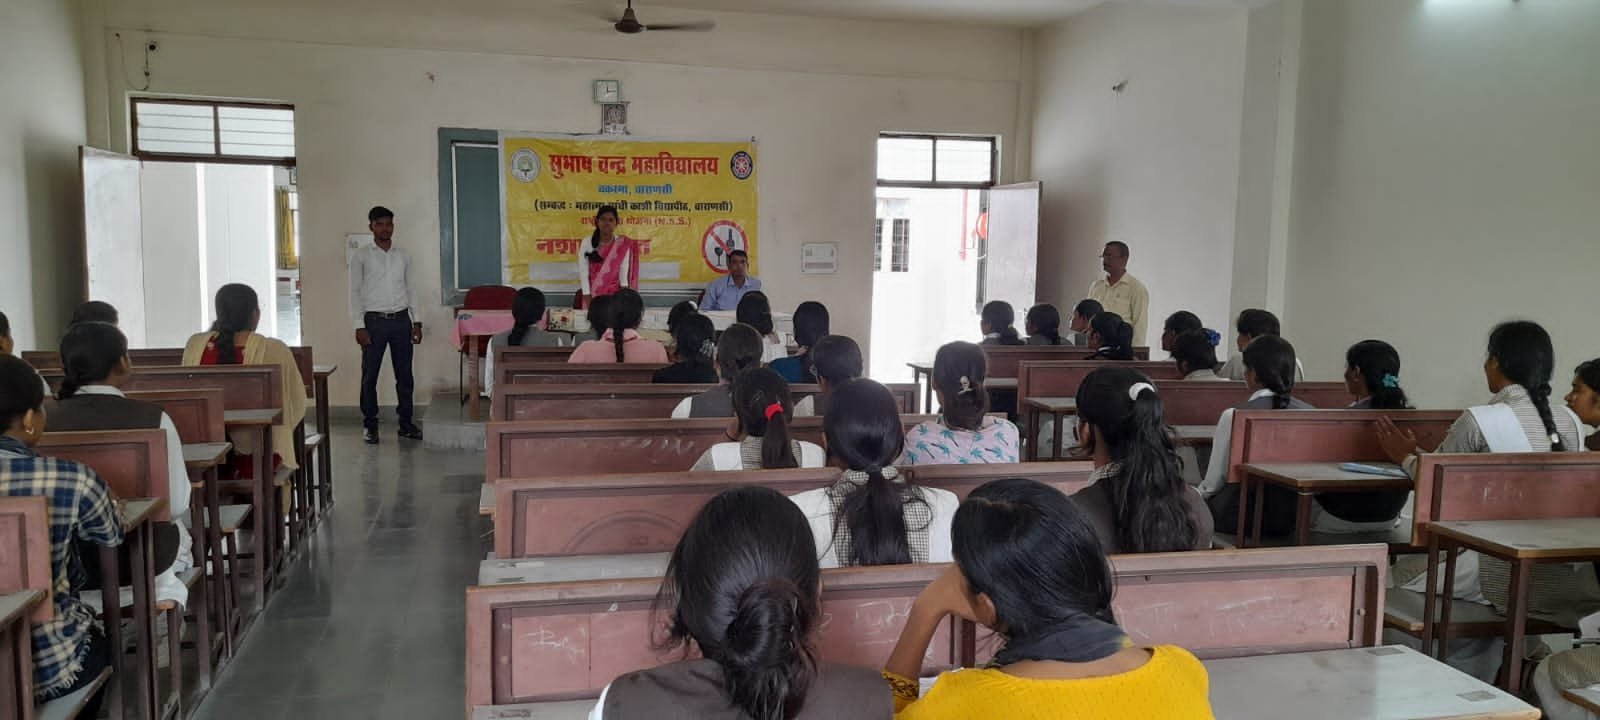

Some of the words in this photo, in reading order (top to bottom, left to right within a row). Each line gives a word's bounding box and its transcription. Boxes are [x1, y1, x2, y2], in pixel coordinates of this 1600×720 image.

[549, 153, 593, 179] सुभाष
[598, 155, 627, 175] चन्द्र
[631, 152, 720, 175] महाविद्यालय
[635, 183, 673, 194] वाराणसी
[630, 200, 652, 211] काशी
